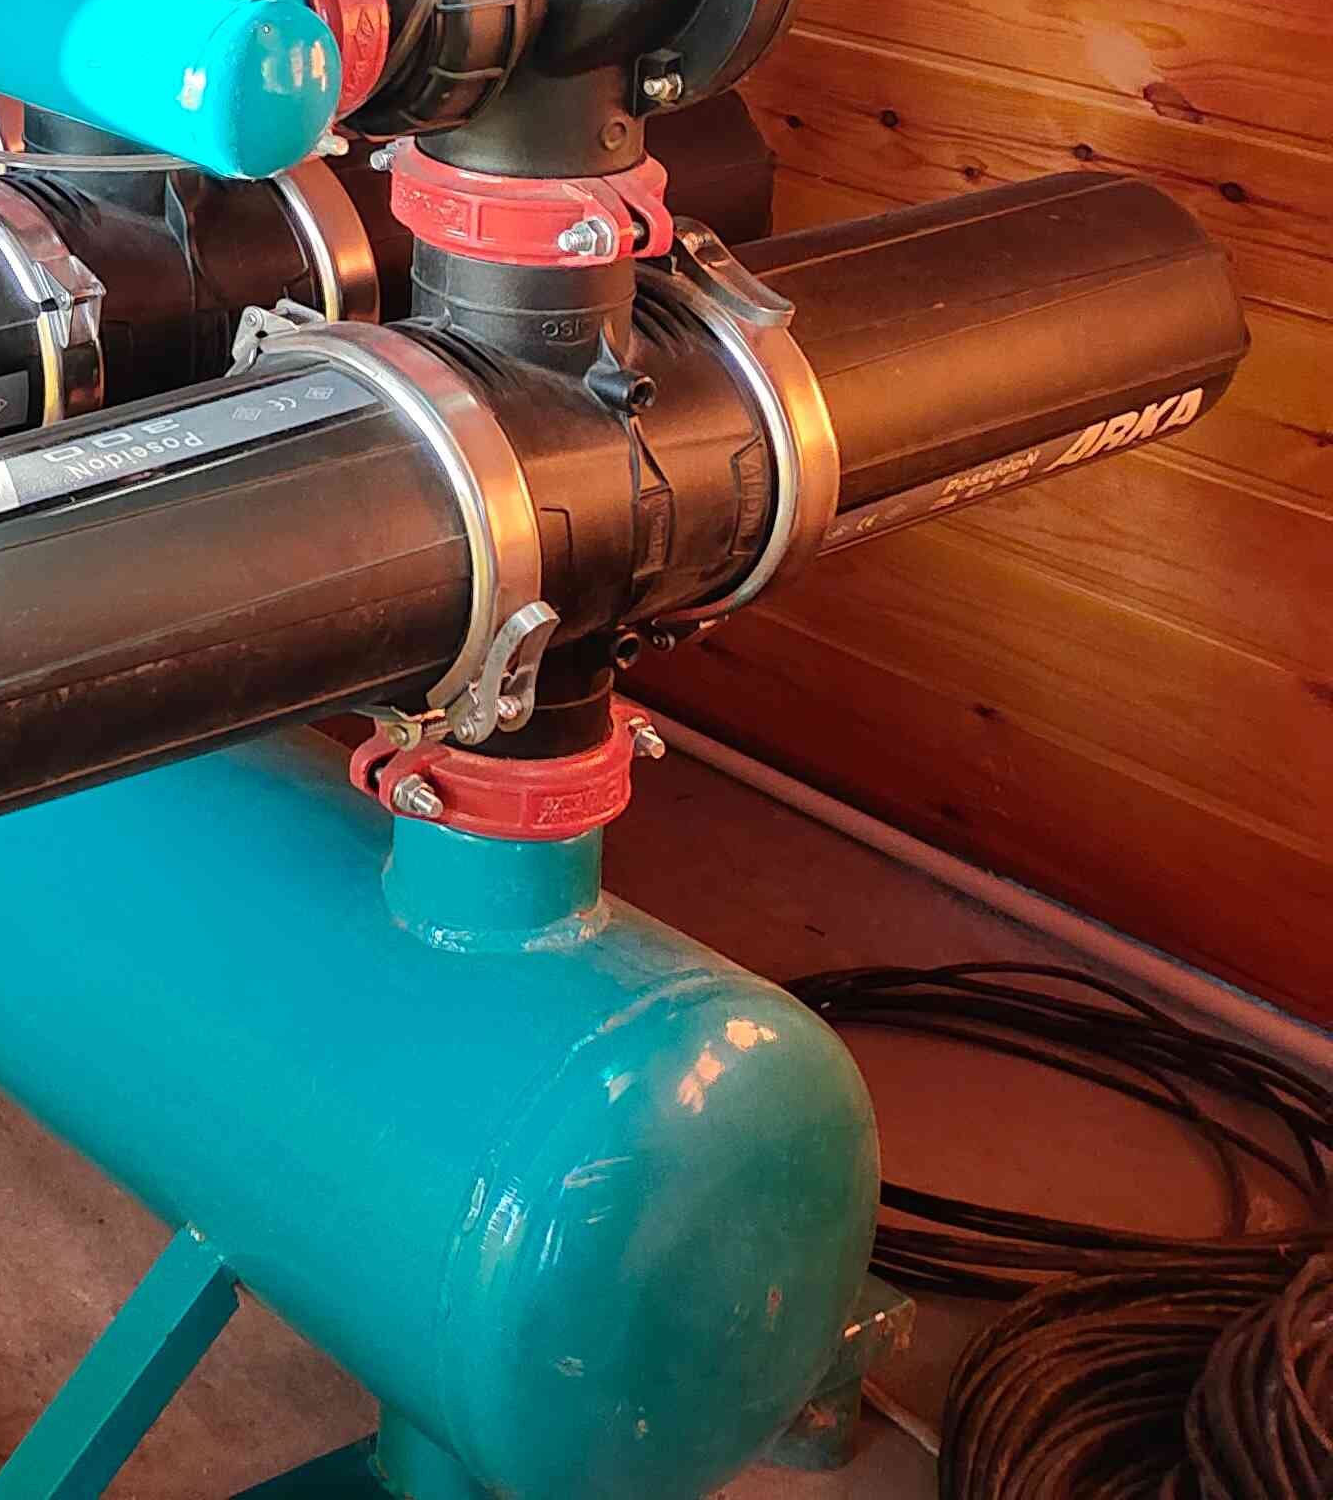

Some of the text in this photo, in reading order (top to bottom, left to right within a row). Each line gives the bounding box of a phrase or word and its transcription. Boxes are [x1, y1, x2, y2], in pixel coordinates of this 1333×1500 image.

[43, 418, 181, 462] 300
[1044, 388, 1203, 472] ARKA
[66, 432, 203, 482] PoseidoN
